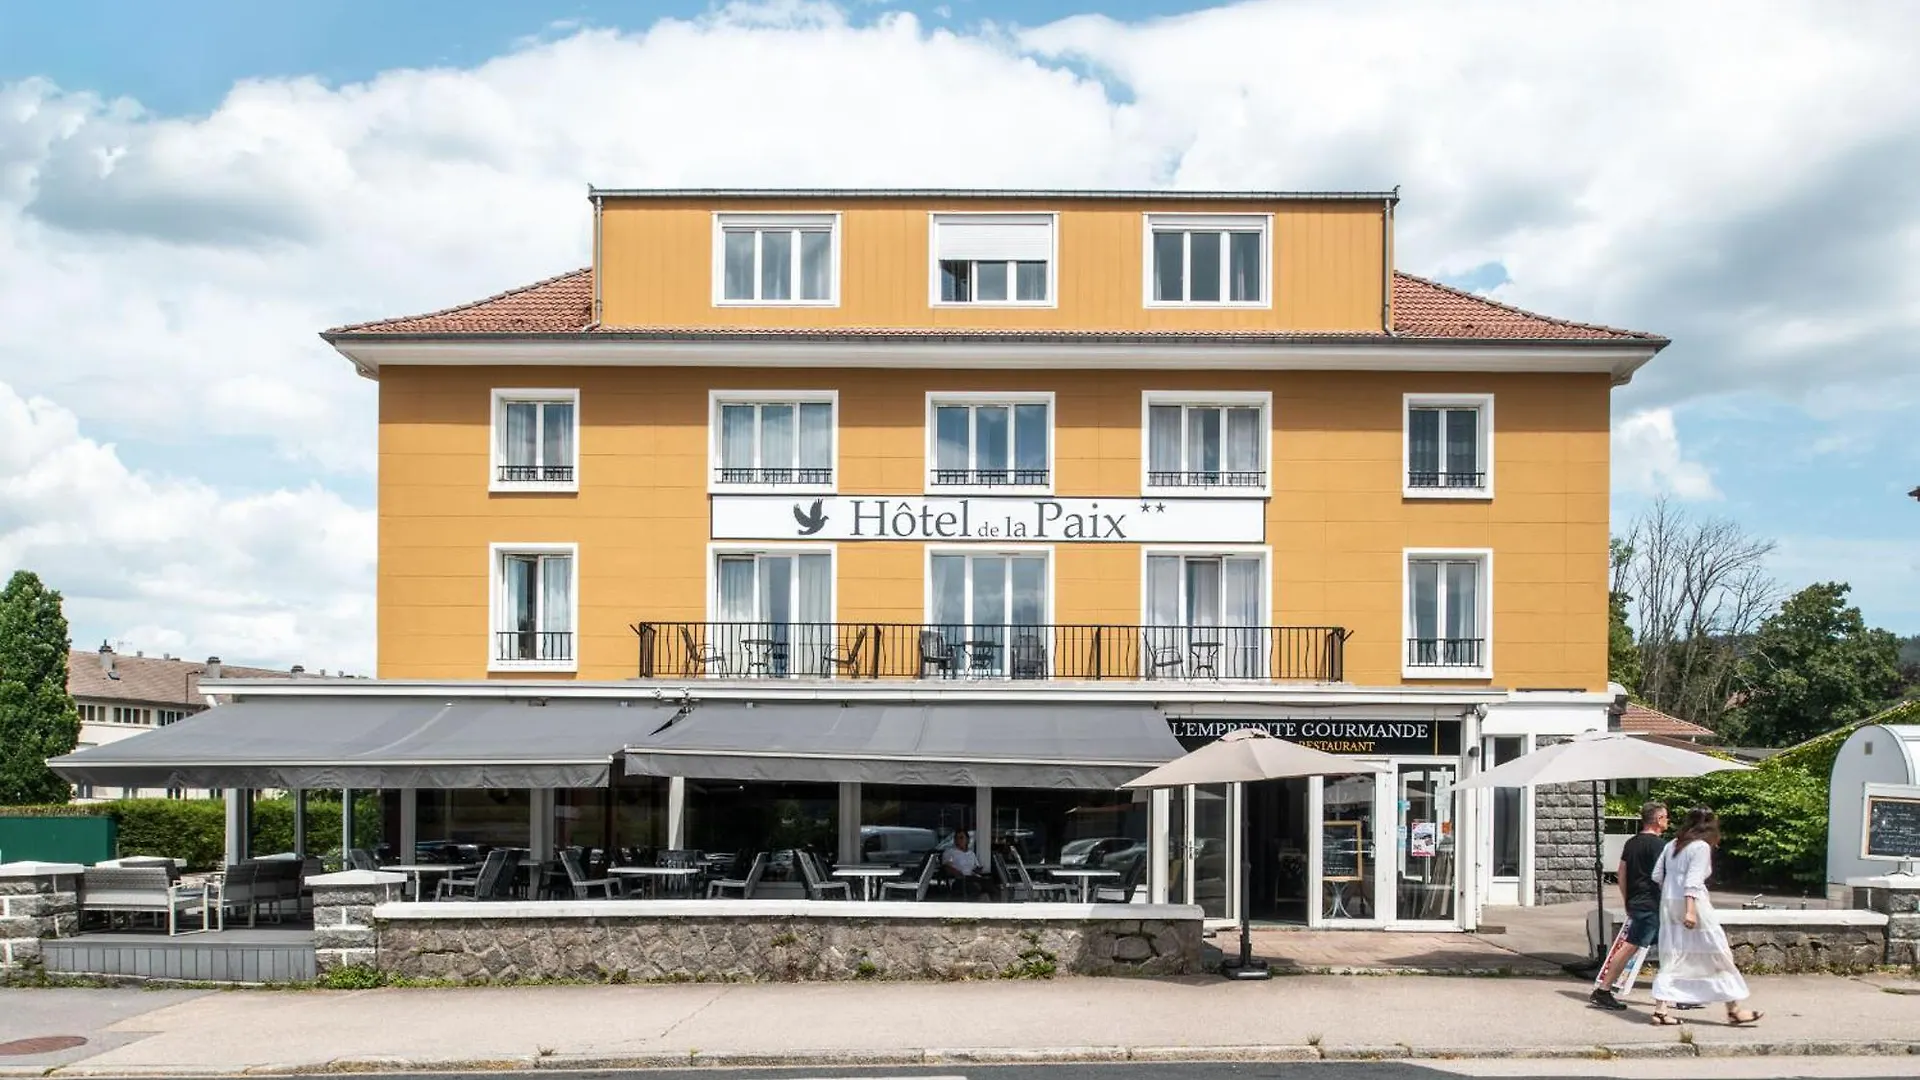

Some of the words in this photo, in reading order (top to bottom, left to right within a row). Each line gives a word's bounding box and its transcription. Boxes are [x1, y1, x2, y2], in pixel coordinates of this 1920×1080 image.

[849, 501, 973, 537] Hôtel
[977, 522, 999, 538] de
[1005, 516, 1027, 538] la
[1033, 501, 1127, 538] Paix
[1301, 722, 1428, 738] GOURMANDE
